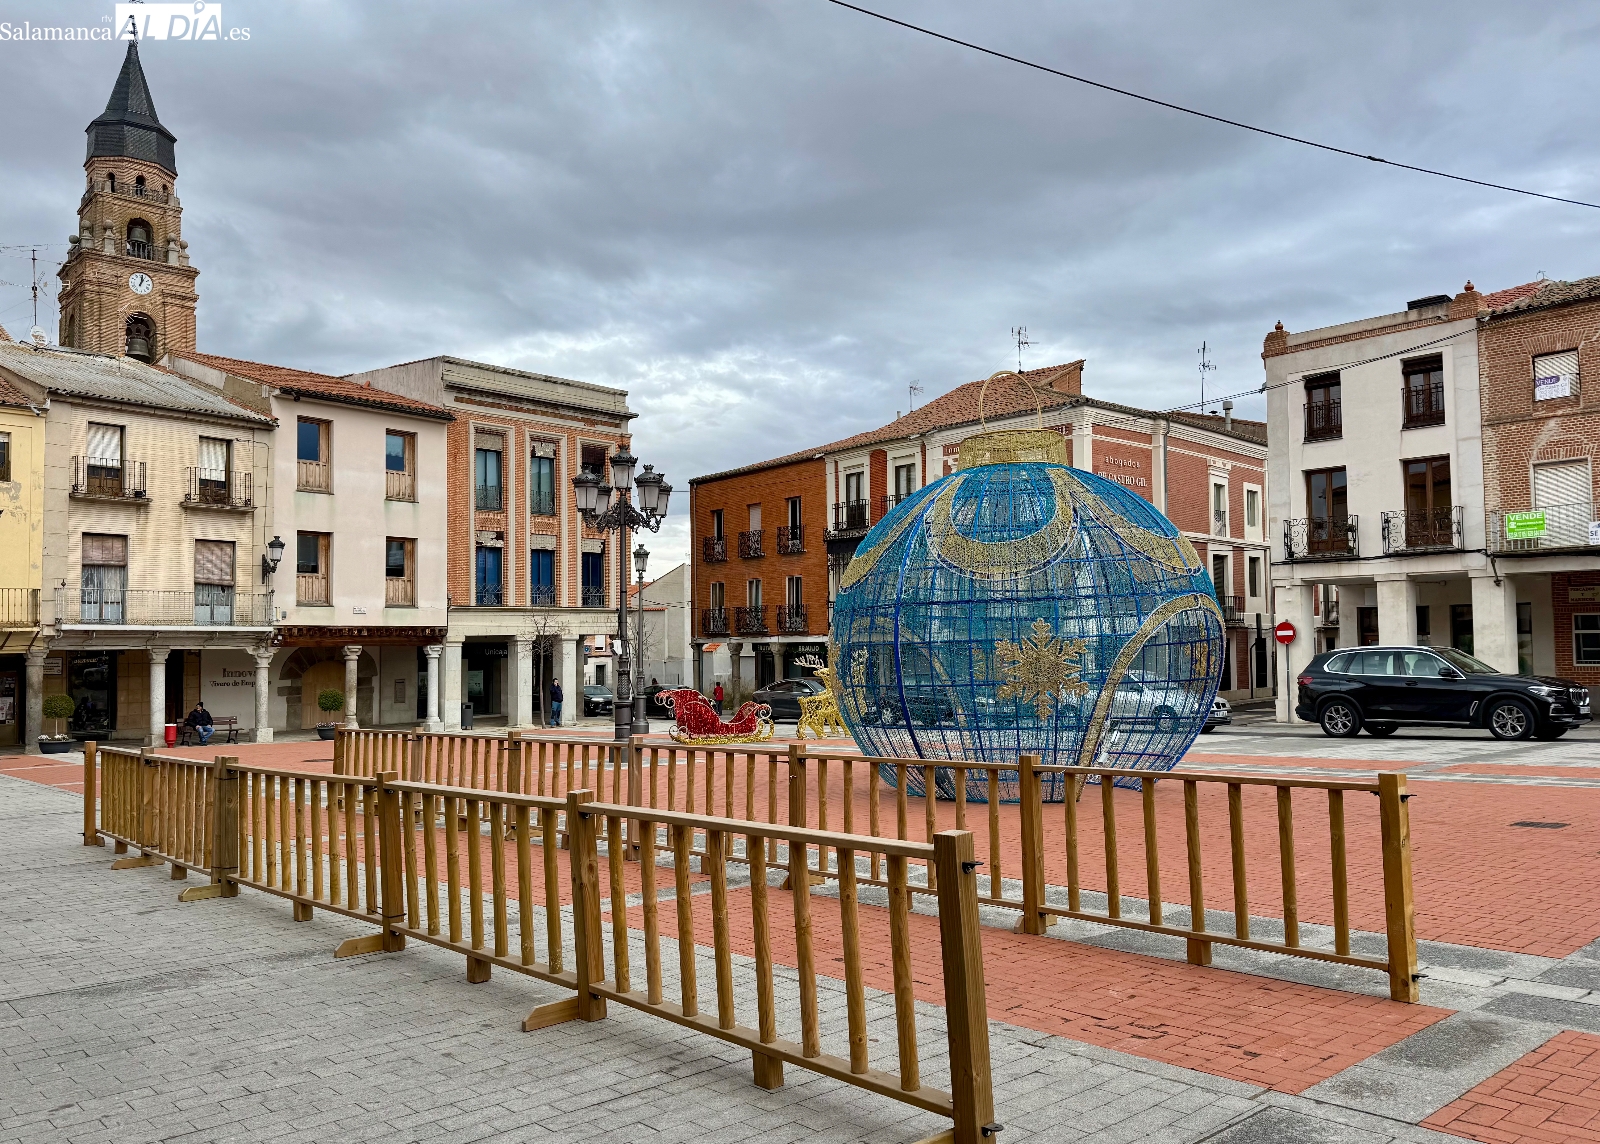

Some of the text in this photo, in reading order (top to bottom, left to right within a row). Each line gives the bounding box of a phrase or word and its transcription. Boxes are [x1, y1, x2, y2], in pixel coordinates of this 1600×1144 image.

[1105, 456, 1140, 468] abogados
[1108, 473, 1135, 485] CASTRO
[1136, 477, 1147, 487] GIL
[1509, 512, 1543, 521] VENDE
[484, 648, 508, 657] Unicaja
